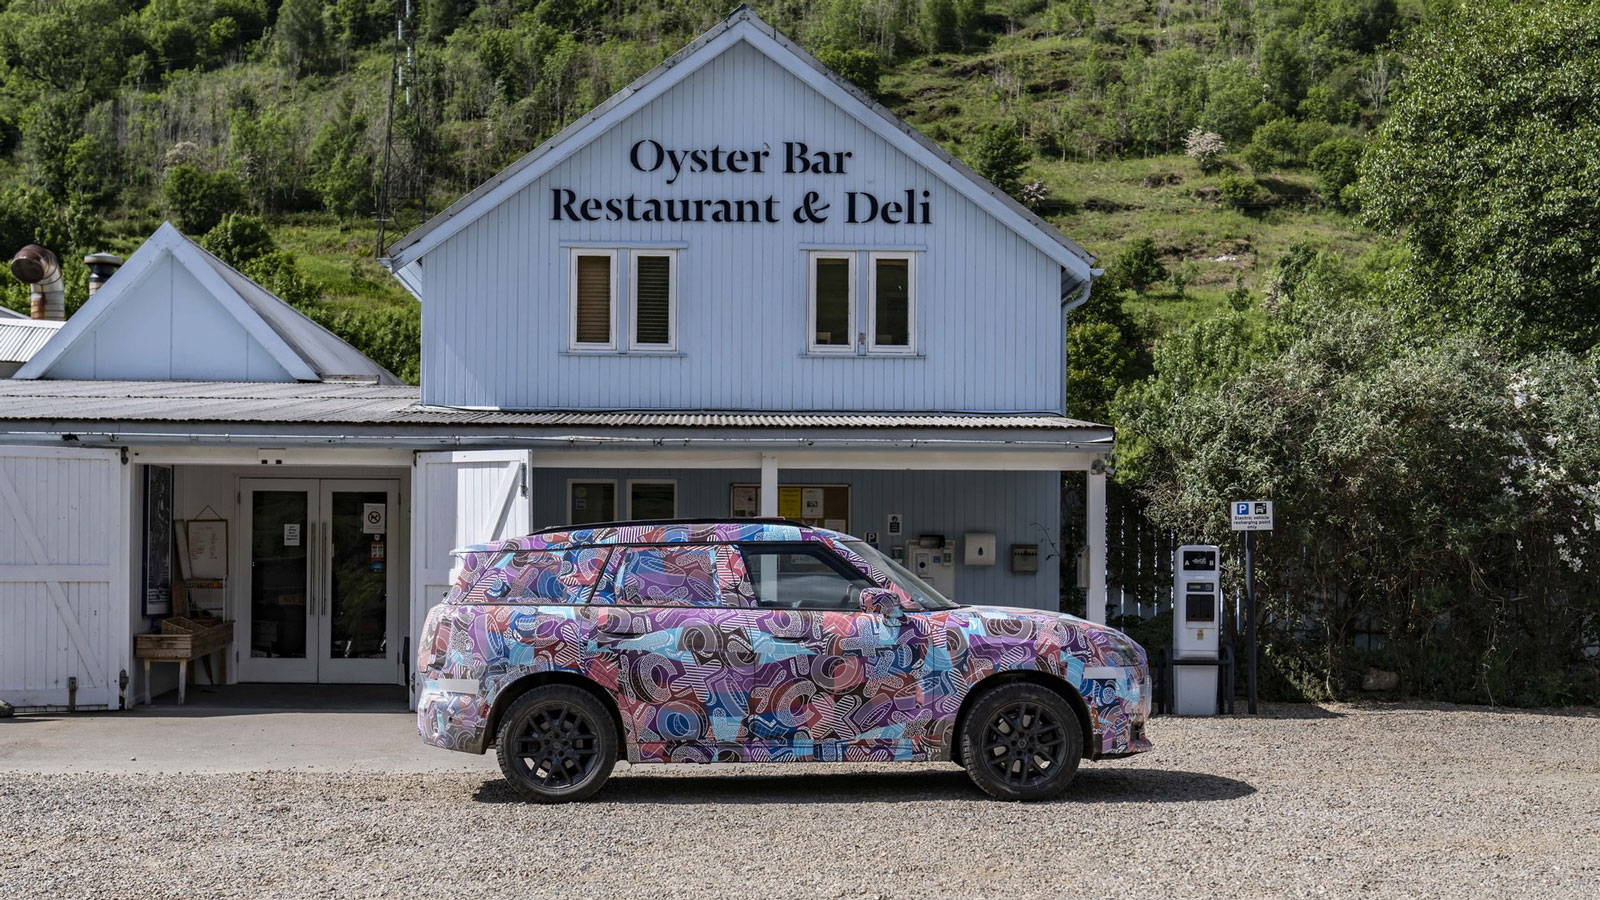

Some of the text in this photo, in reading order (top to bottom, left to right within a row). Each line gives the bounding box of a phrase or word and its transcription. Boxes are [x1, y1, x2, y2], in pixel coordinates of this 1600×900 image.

[629, 139, 853, 185] Oyster Bar
[549, 188, 932, 225] Restaurant & Deli
[1239, 504, 1246, 513] P
[868, 533, 875, 541] P
